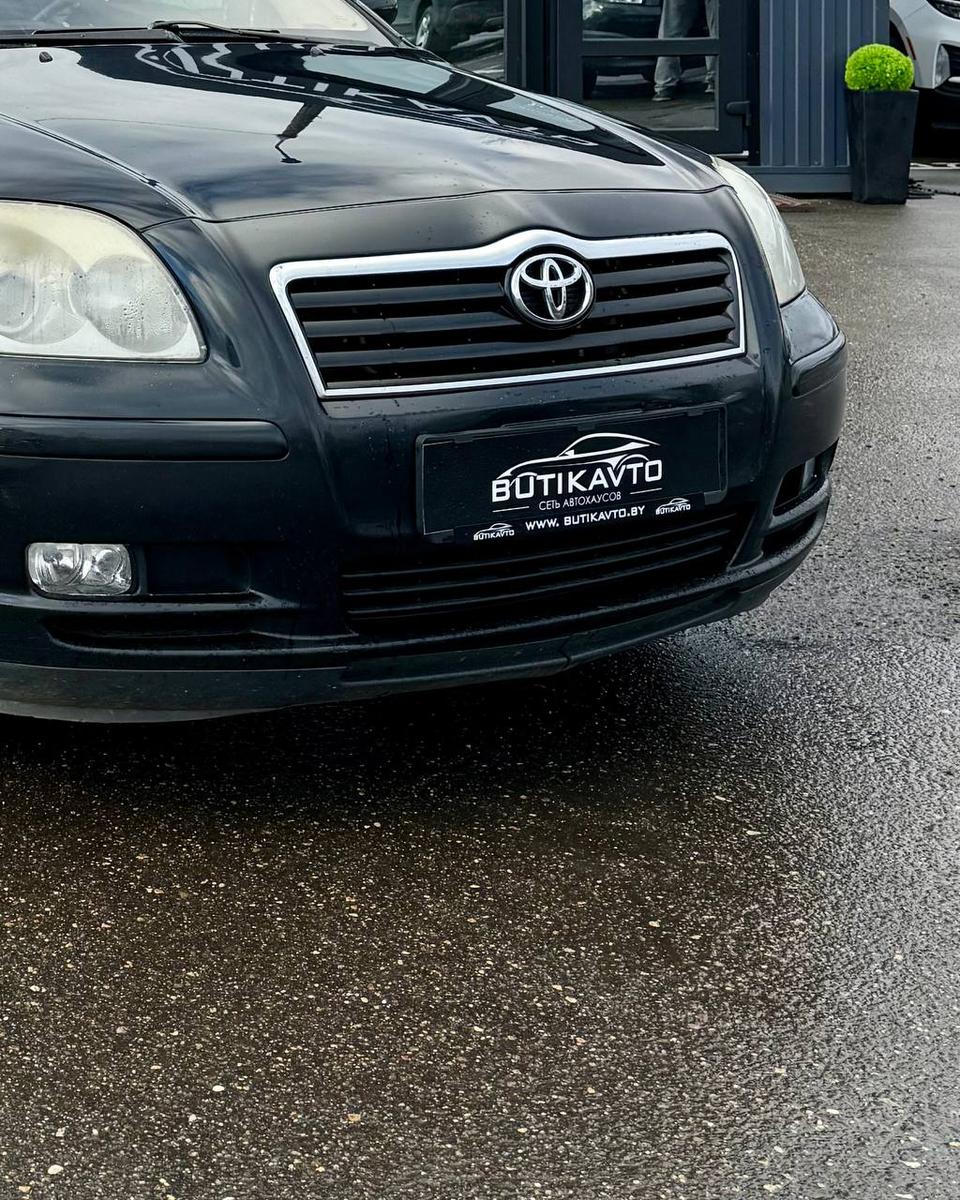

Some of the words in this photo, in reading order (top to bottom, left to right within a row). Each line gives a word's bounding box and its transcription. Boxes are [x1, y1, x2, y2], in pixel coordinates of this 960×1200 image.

[492, 459, 662, 502] BUTIKAVTO
[538, 500, 561, 511] СЕТЬ
[562, 492, 622, 508] АВТОХАУСОВ
[655, 503, 691, 515] BUTIKAVTO
[525, 518, 559, 531] WWW.
[564, 505, 645, 526] BUTIKAVTO.BY
[473, 529, 515, 541] BUTIKAVTO
